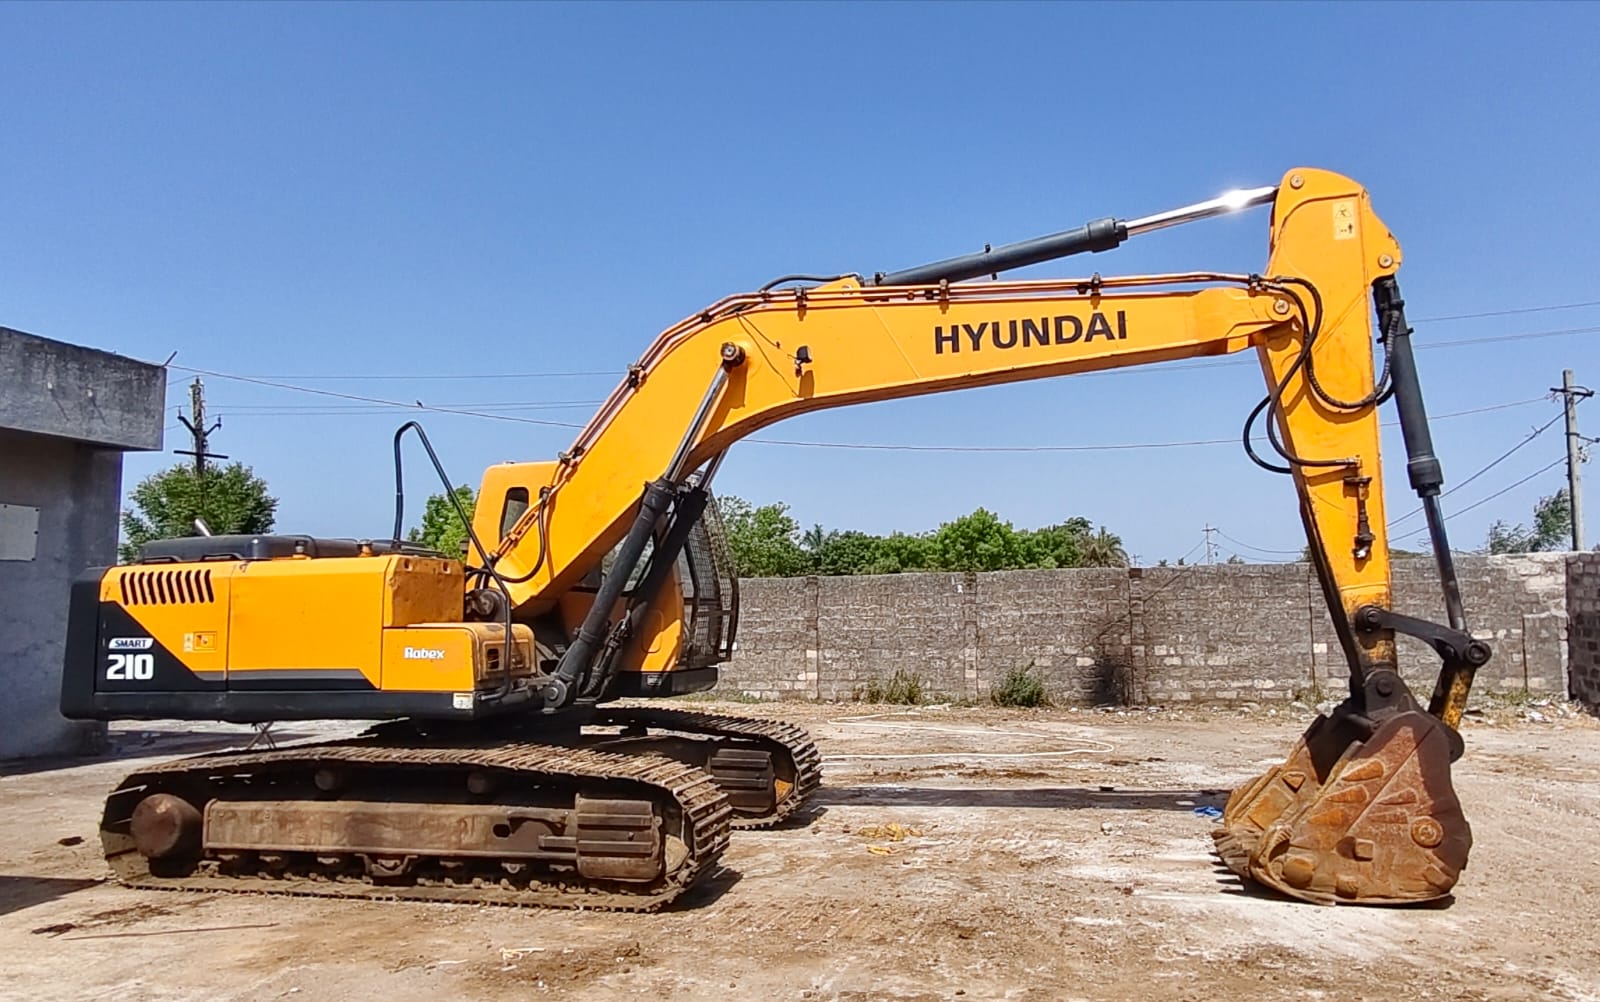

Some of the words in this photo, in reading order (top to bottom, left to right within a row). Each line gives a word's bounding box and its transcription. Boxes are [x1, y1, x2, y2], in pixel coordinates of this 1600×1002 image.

[935, 310, 1127, 354] HYUNDAI
[114, 639, 147, 648] SMART
[106, 654, 154, 680] 210
